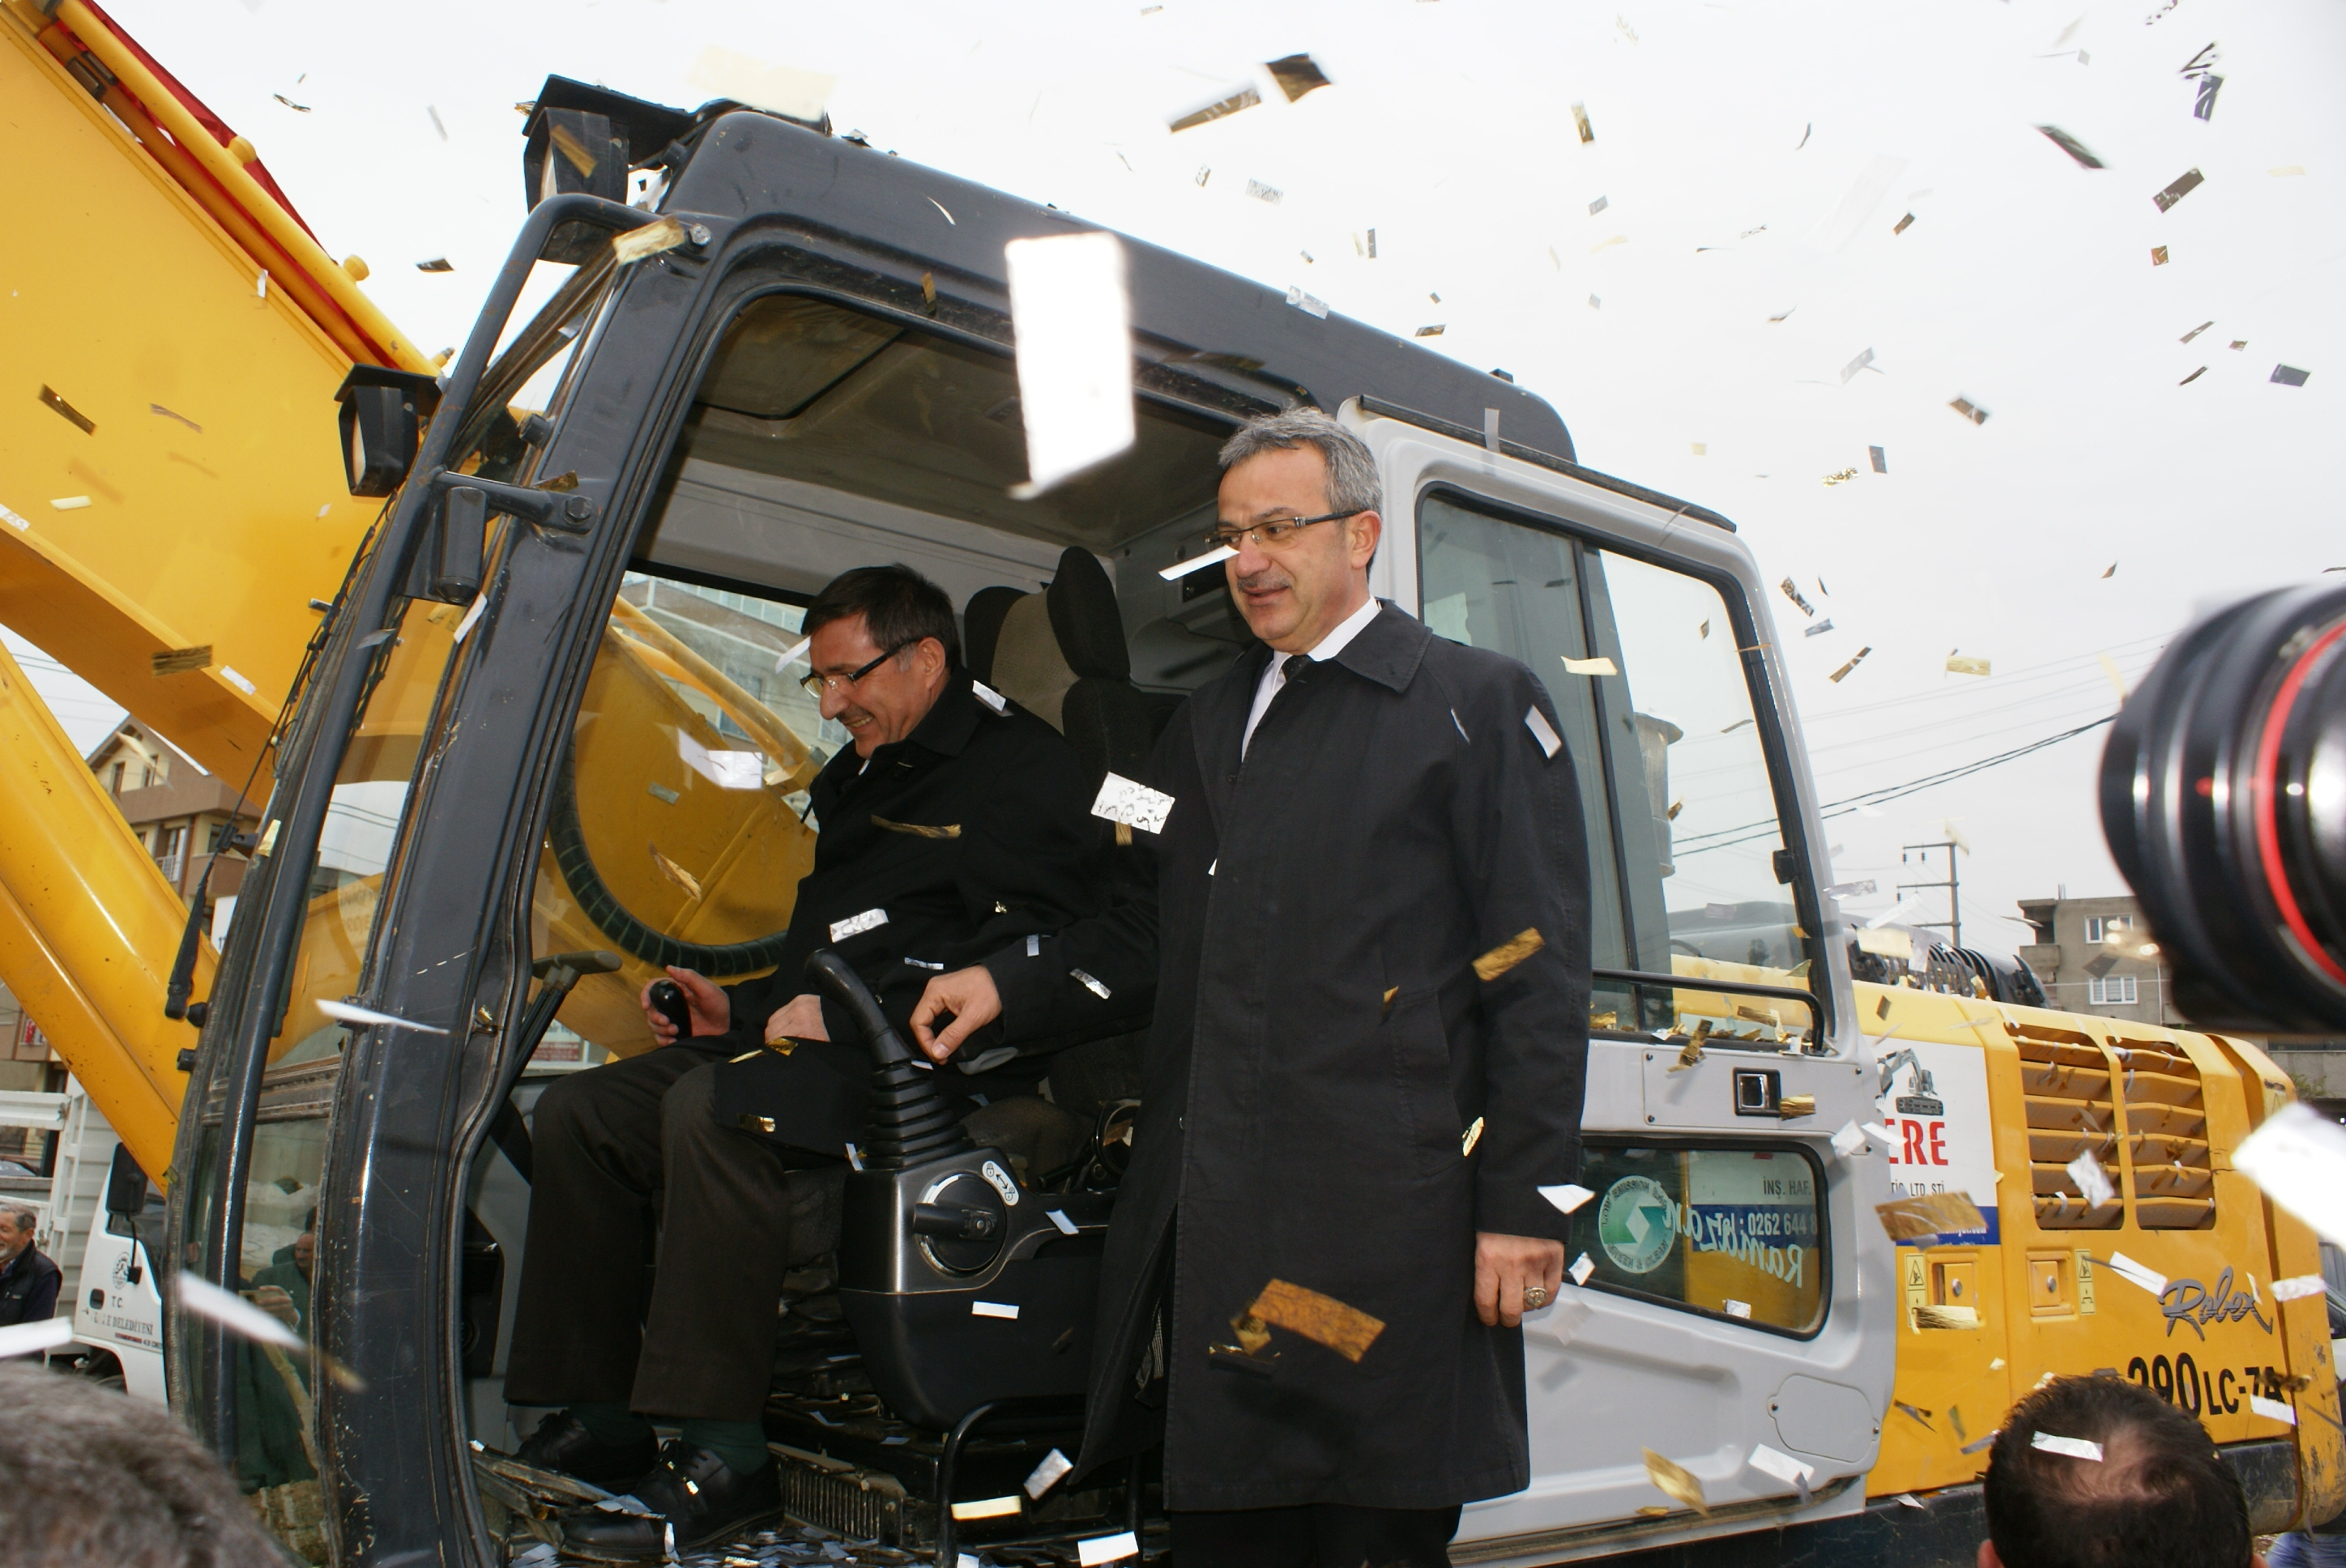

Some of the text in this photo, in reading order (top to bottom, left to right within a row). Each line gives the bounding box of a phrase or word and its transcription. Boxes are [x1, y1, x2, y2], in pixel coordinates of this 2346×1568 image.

[1611, 1180, 1650, 1200] EMISSION
[1789, 1180, 1812, 1195] HAF.
[1747, 1212, 1781, 1236] 0262
[1784, 1212, 1807, 1236] 644
[1608, 1242, 1634, 1269] GREEN
[1644, 1239, 1668, 1268] CLEAN
[2157, 1266, 2273, 1342] Robex
